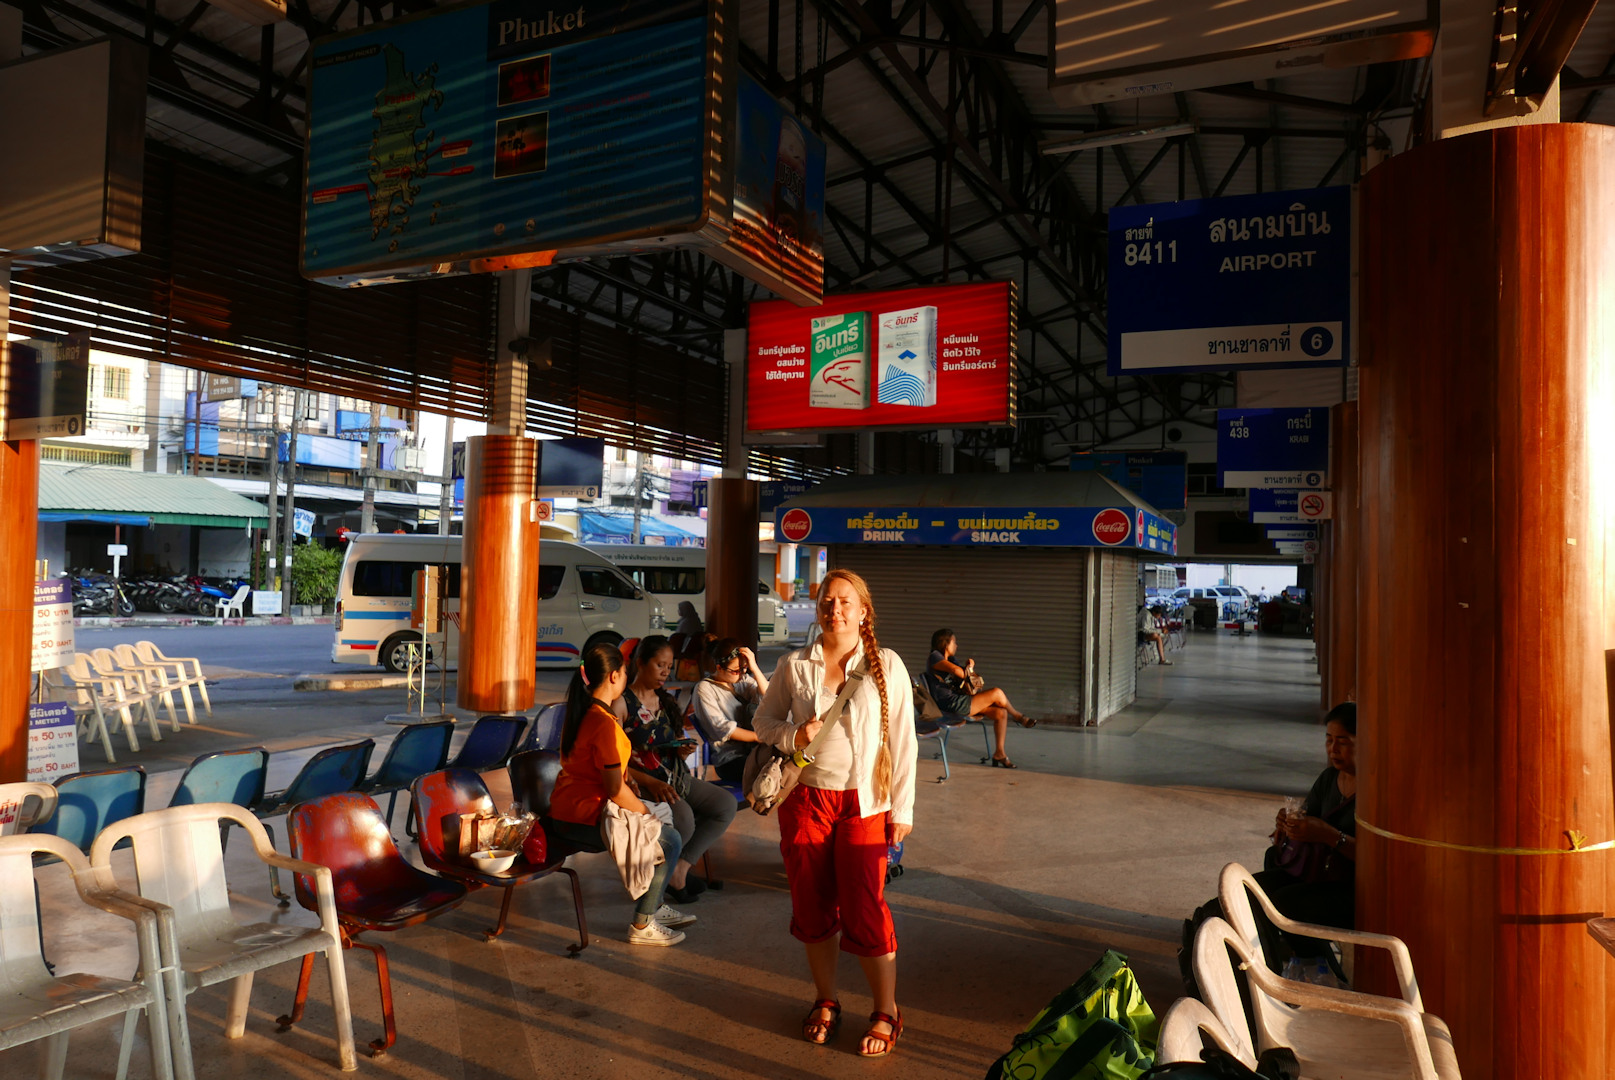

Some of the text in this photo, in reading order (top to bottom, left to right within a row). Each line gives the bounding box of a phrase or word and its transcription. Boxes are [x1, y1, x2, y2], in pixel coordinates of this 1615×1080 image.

[498, 5, 587, 47] Phuket
[1125, 202, 1331, 243] สายที่ สนามบิน
[1125, 240, 1177, 266] 8411
[1219, 250, 1317, 273] AIRPORT
[815, 319, 859, 354] อินทรี
[1208, 325, 1323, 355] ชานชาลาที่ 6
[1287, 408, 1312, 430] กระบี่
[1229, 426, 1250, 439] 438
[847, 512, 919, 530] เครื่องดื่ม
[958, 512, 1060, 531] ขนมขบเคี้ยว
[863, 531, 1020, 543] DRINK SNACK
[38, 608, 69, 618] 50 บาท
[41, 639, 53, 649] 50
[56, 639, 72, 648] BAHT
[35, 717, 60, 726] METER
[42, 731, 55, 741] 50
[58, 731, 73, 740] บาท
[46, 762, 58, 772] 50
[61, 762, 77, 770] BAHT
